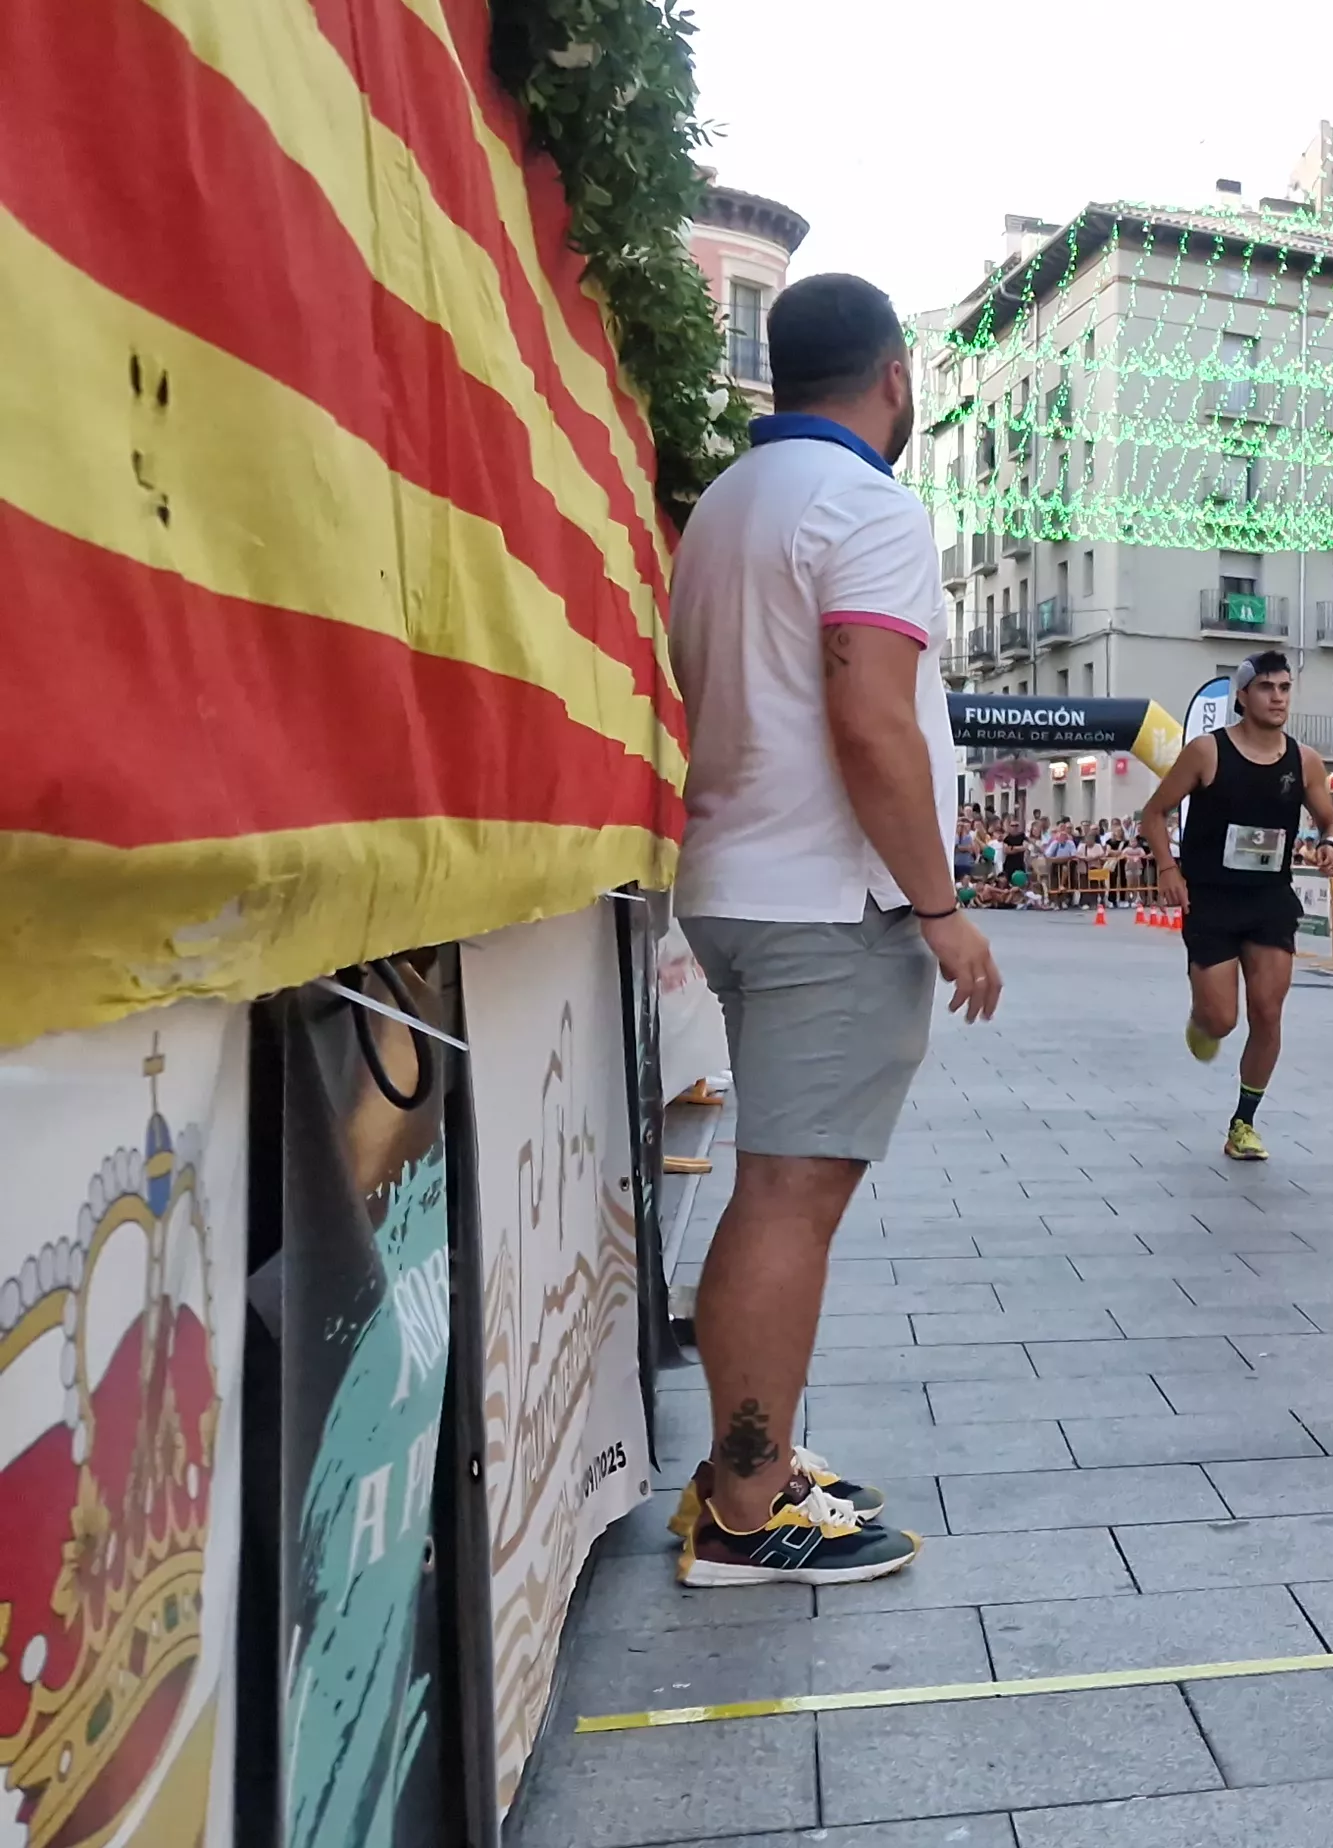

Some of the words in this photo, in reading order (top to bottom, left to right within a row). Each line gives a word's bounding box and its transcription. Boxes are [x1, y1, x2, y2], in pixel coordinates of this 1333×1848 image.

[964, 706, 1085, 727] FUNDACIÓN
[976, 728, 1025, 741] RURAL
[1030, 730, 1049, 741] DE
[1054, 730, 1115, 742] ARAGÓN
[1252, 830, 1266, 845] 3
